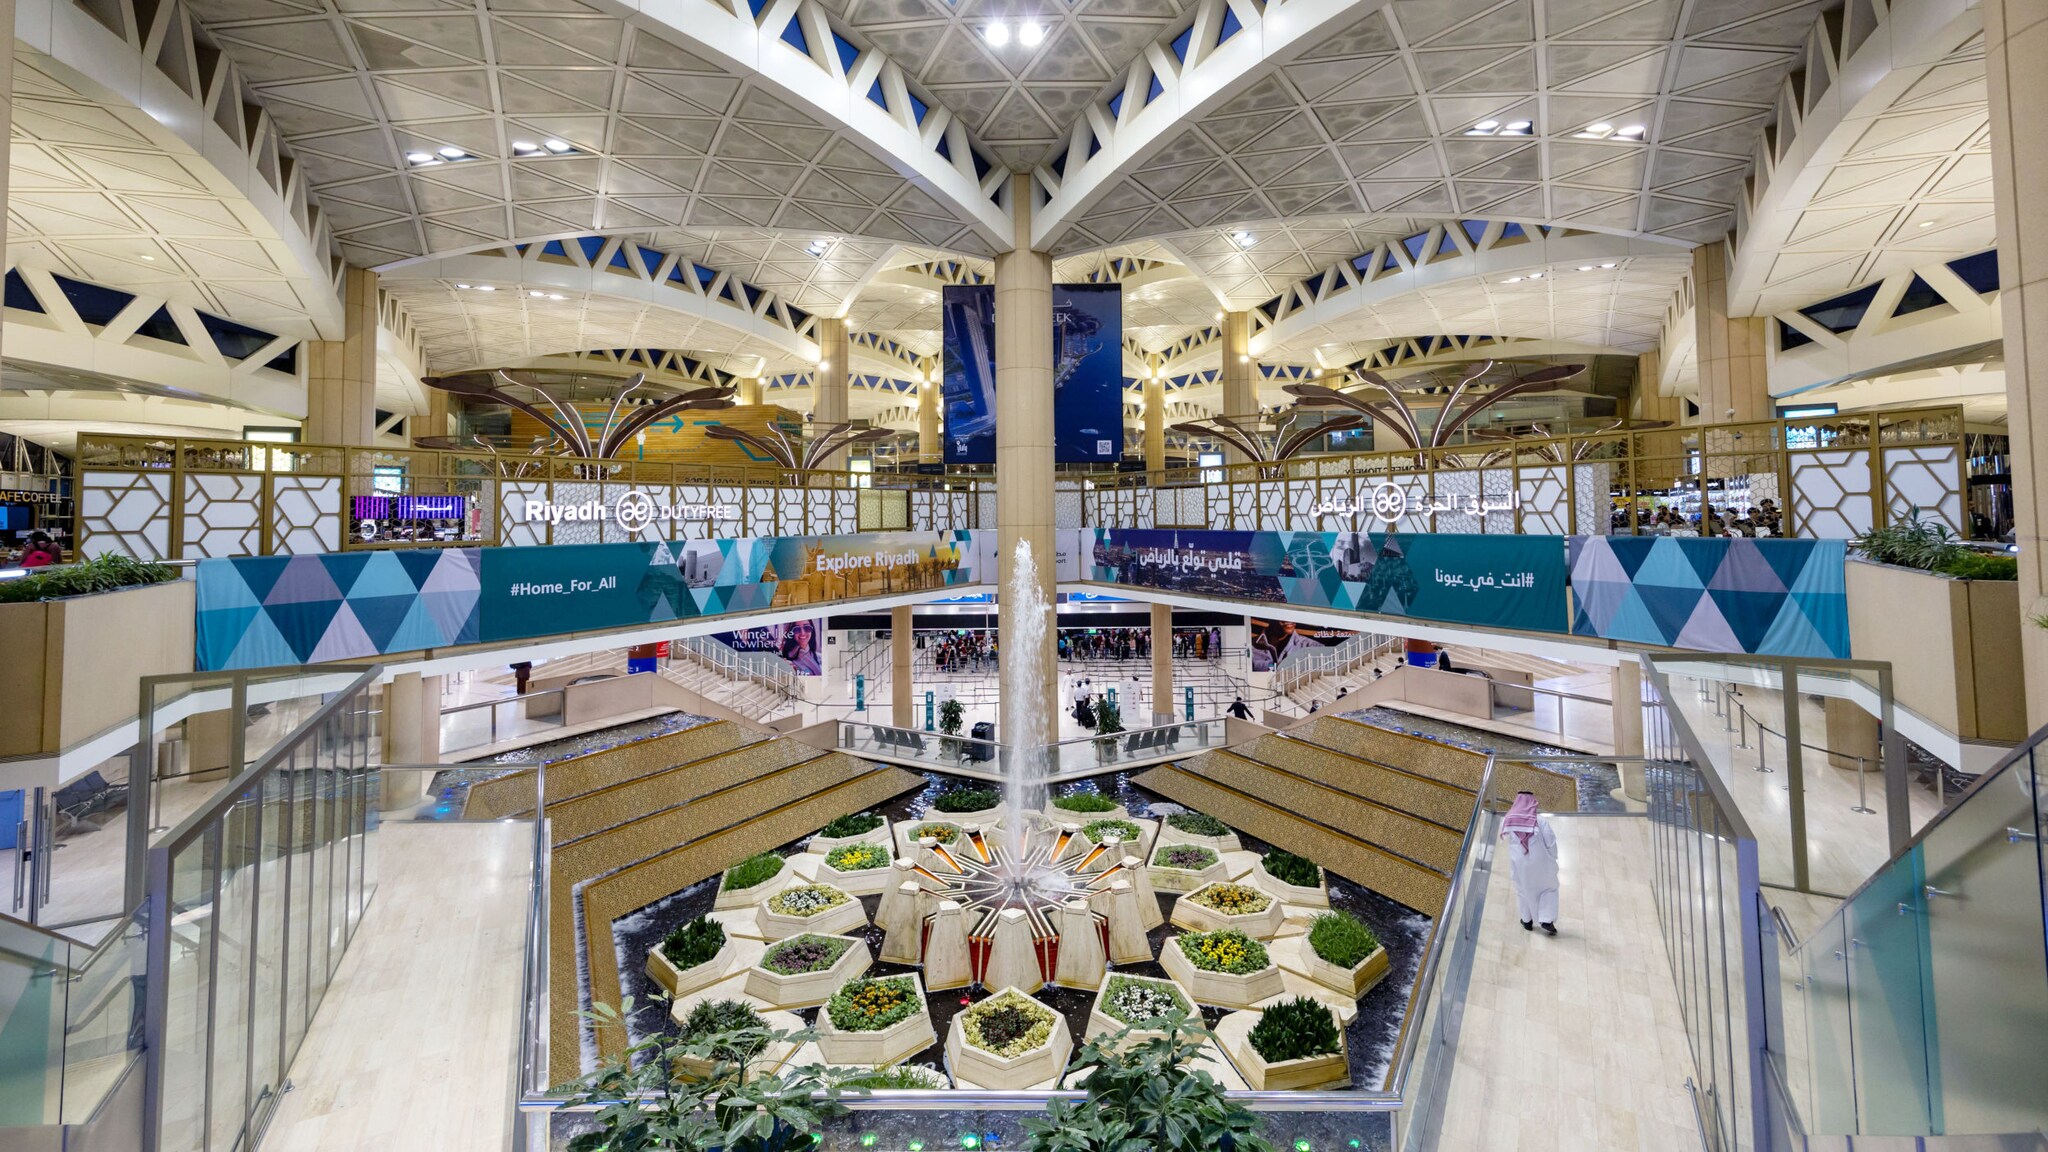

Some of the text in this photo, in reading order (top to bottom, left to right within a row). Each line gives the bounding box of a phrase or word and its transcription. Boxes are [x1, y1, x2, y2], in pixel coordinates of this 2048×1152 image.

[525, 500, 606, 525] Riyadh
[1310, 495, 1364, 517] الرياض
[1414, 493, 1458, 517] الحرة
[1463, 490, 1520, 516] السوق
[816, 549, 919, 574] Explore Riyadh
[1140, 546, 1179, 571] بالرياض
[1208, 551, 1242, 579] قلبي
[510, 576, 616, 597] #Home_For_All
[732, 628, 794, 640] Winter like
[732, 638, 782, 648] nowhere
